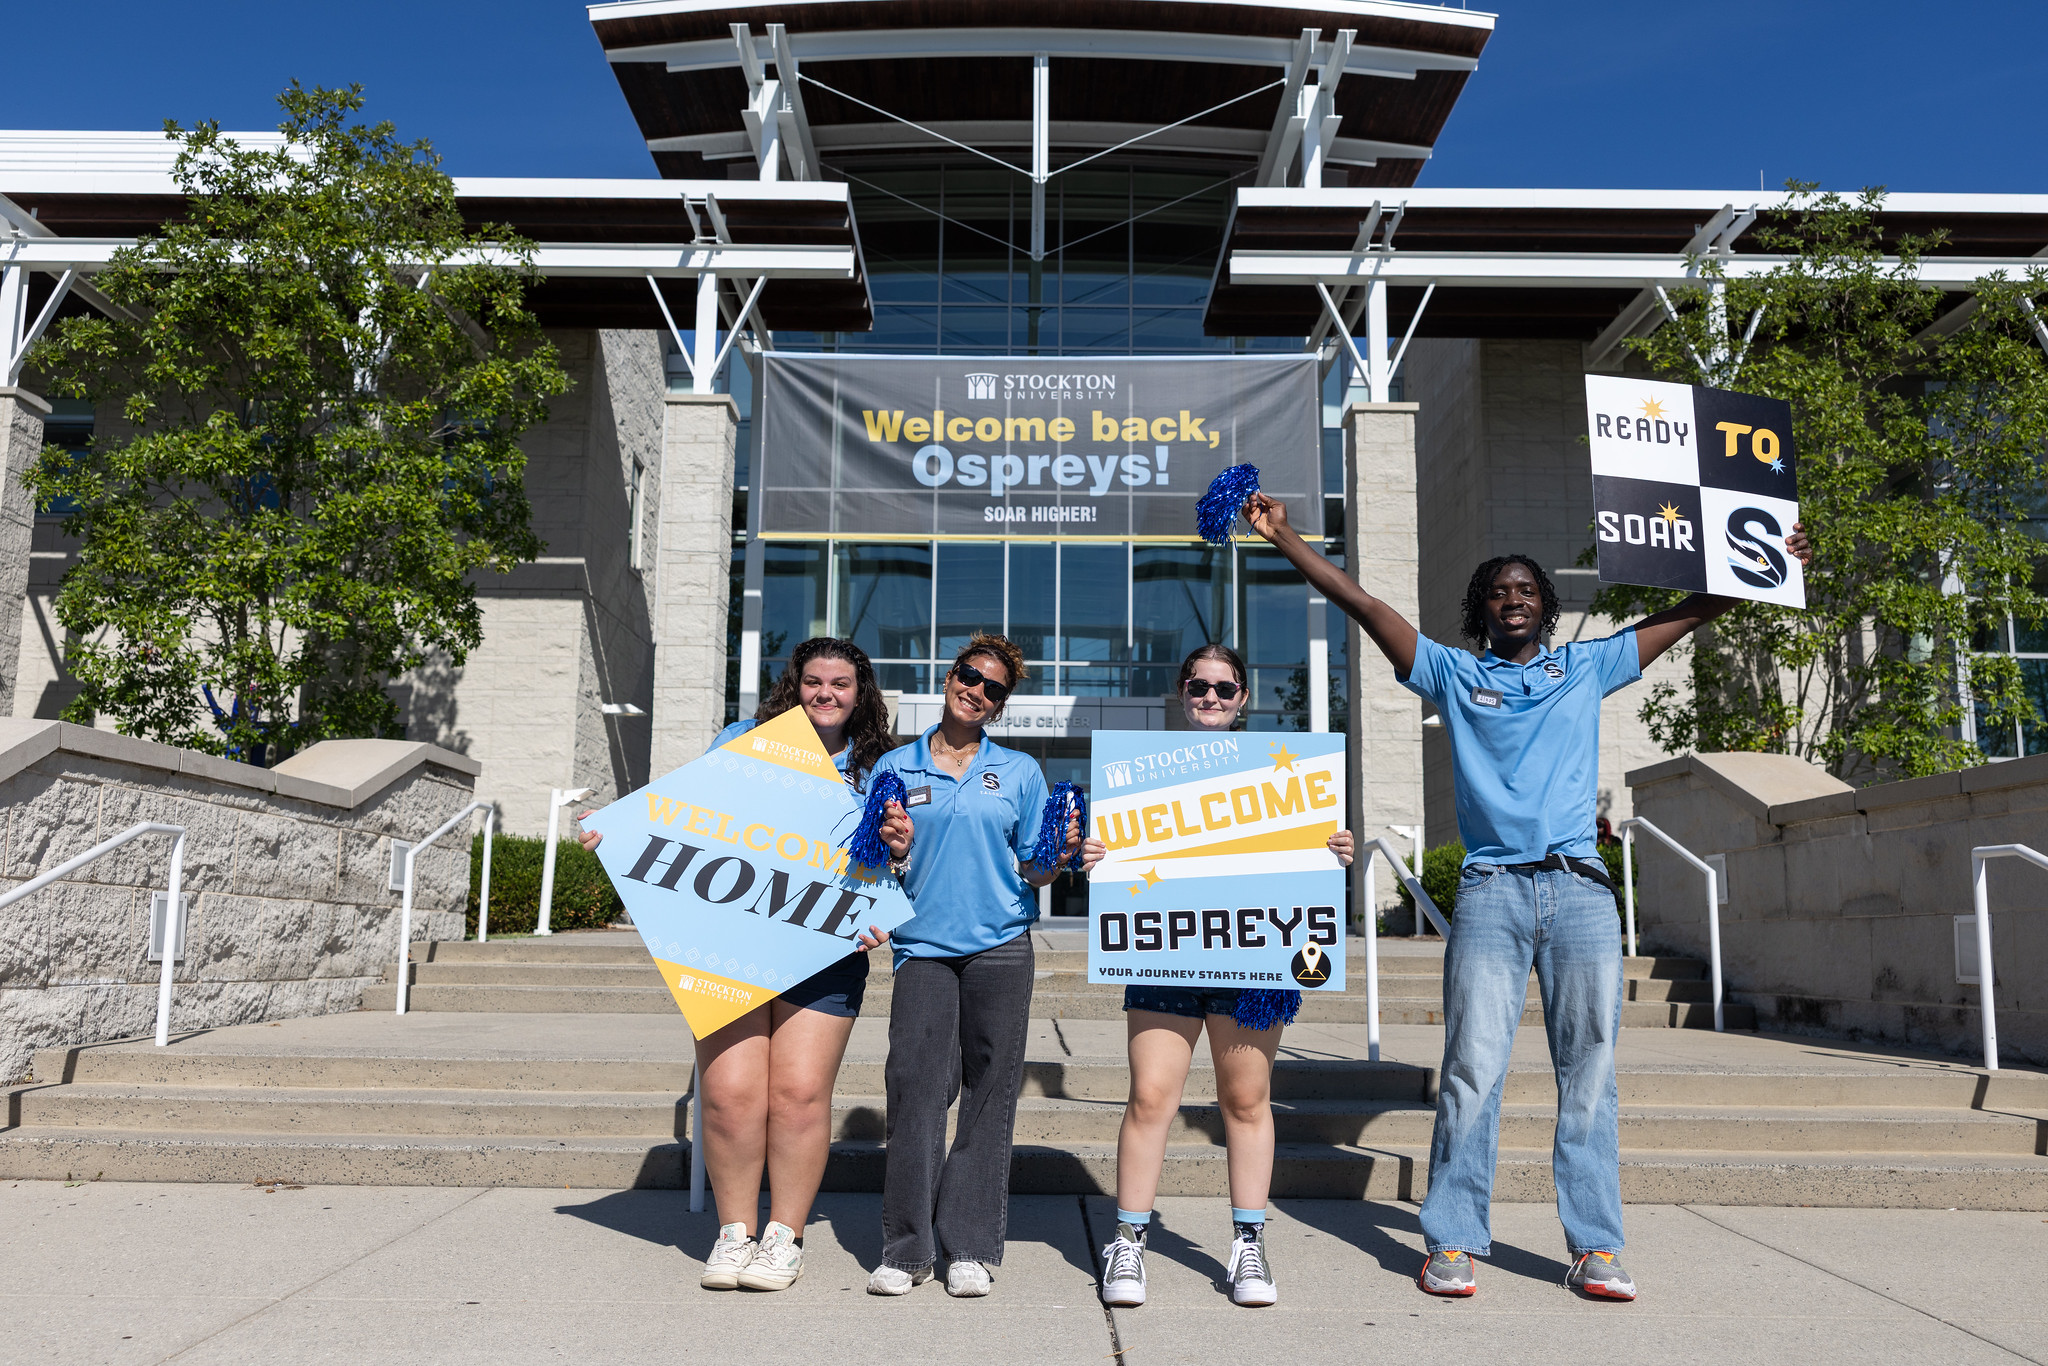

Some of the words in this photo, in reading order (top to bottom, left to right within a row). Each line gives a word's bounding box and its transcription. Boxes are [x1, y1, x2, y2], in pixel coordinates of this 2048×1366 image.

[1003, 374, 1116, 390] STOCKTON
[1003, 391, 1116, 400] UNIVERSITY
[863, 410, 1075, 442] Welcome
[1093, 410, 1220, 448] back,
[1596, 413, 1688, 447] READY
[1716, 421, 1780, 464] TO
[912, 444, 1170, 496] Ospreys!
[984, 506, 1027, 522] SOAR
[1031, 506, 1097, 523] HIGHER!
[1598, 510, 1696, 552] SOAR
[1036, 716, 1091, 729] CENTER
[767, 749, 821, 767] UNIVERSITY
[769, 741, 823, 763] STOCKTON
[1134, 738, 1239, 772] STOCKTON
[1137, 754, 1240, 783] UNIVERSITY
[1097, 770, 1338, 852] WELCOME
[621, 833, 878, 942] HOME
[1099, 905, 1338, 952] OSPREYS
[1099, 967, 1133, 977] YOUR
[1137, 968, 1196, 979] JOURNEY
[1199, 970, 1246, 981] STARTS
[1249, 972, 1283, 982] HERE
[694, 988, 750, 1006] UNIVERSITY
[696, 978, 752, 1001] STOCKTON
